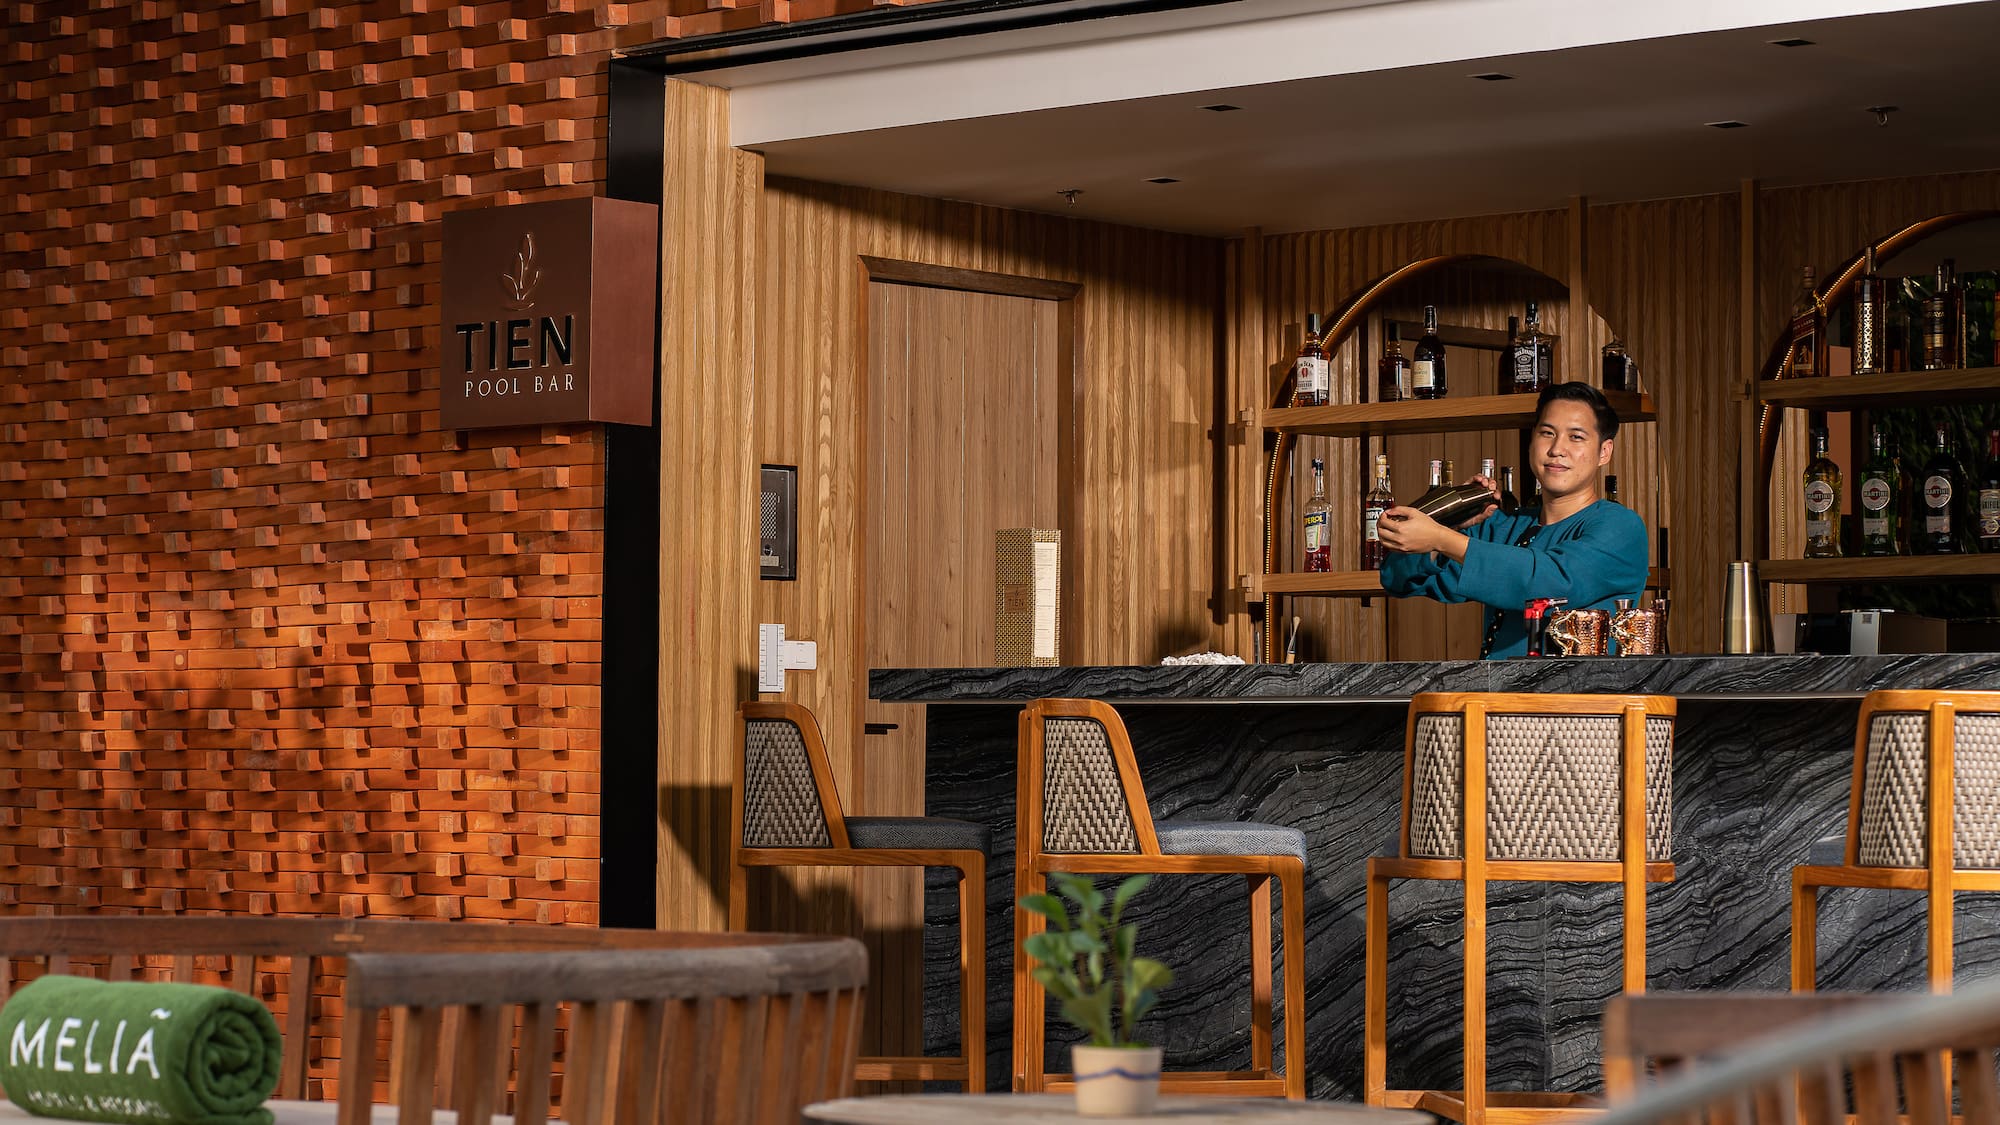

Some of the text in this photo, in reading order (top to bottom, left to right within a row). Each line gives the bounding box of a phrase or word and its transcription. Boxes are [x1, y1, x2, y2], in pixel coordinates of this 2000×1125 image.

[456, 314, 575, 373] TIEN
[465, 373, 573, 397] POOL BAR
